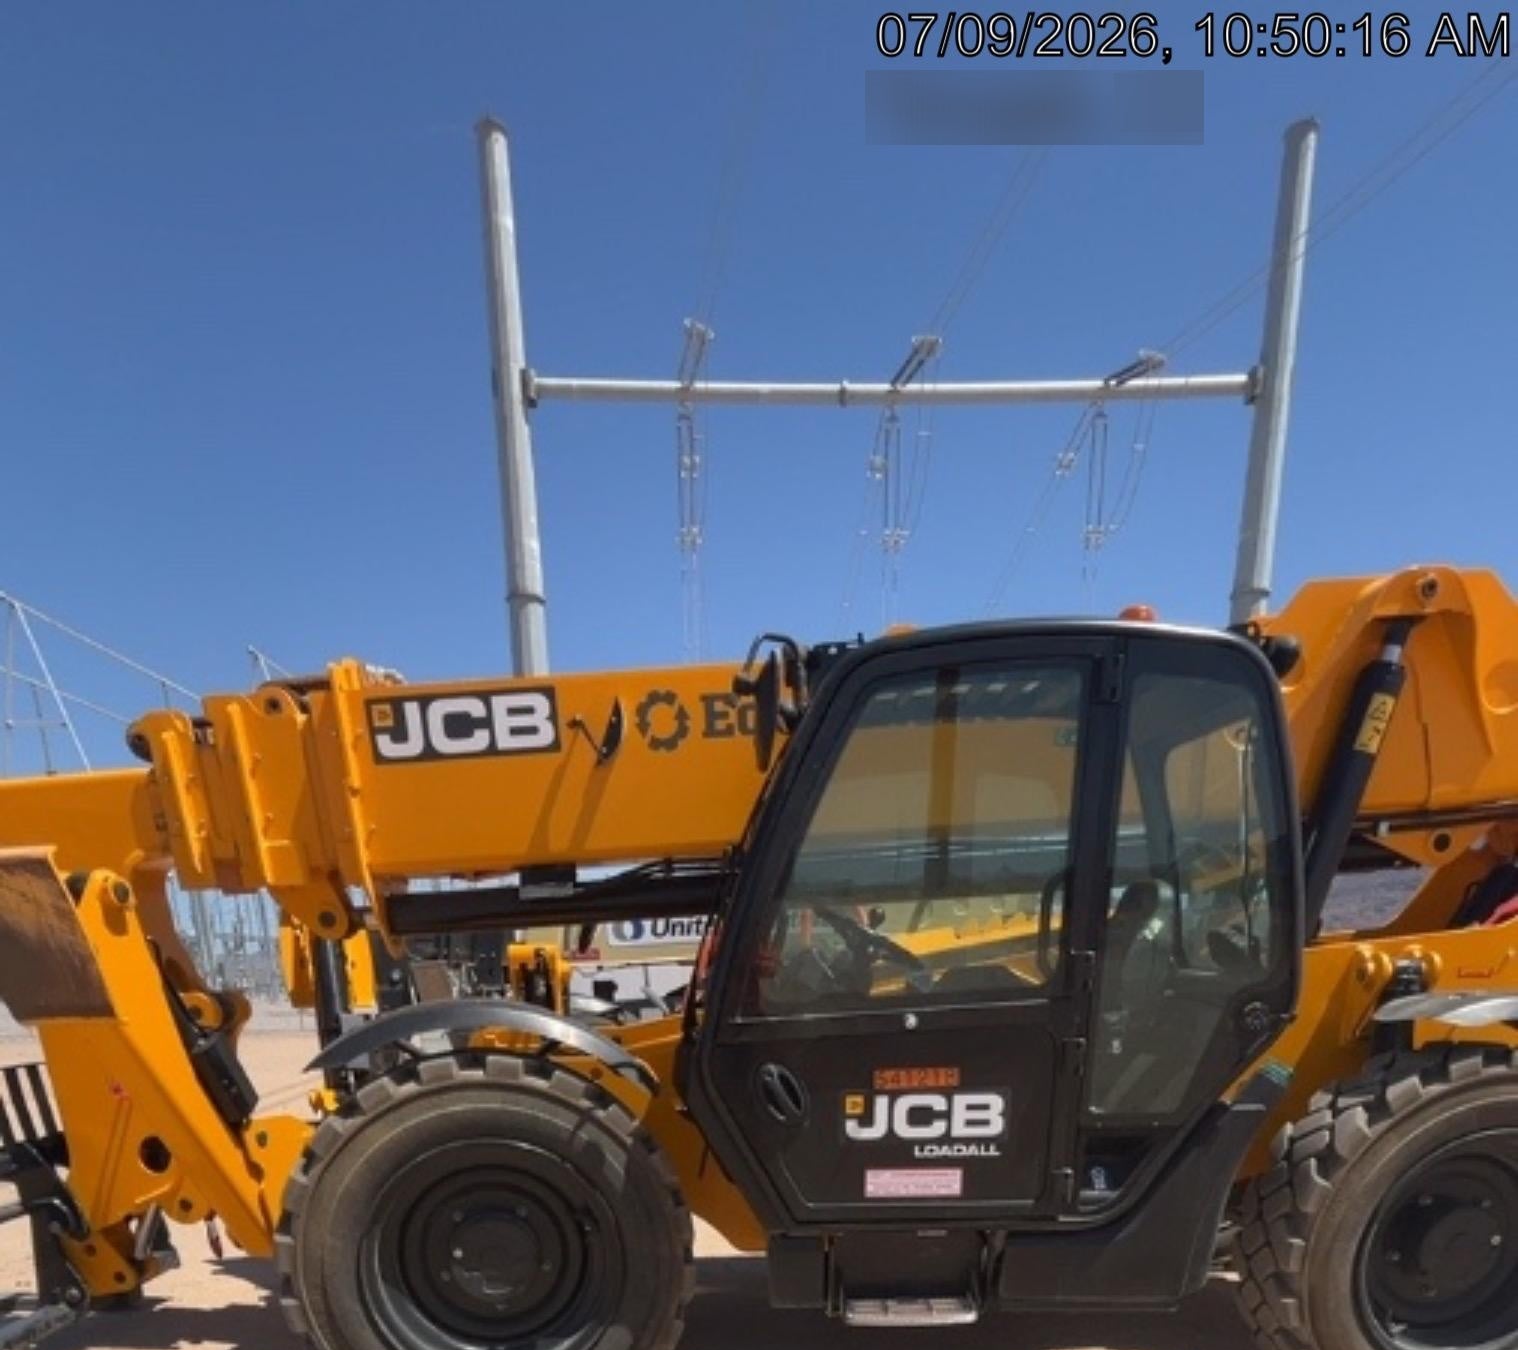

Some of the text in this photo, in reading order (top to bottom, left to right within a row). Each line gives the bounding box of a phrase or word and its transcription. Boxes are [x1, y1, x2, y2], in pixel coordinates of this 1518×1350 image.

[375, 692, 556, 759] JCB
[845, 1093, 1005, 1140] JCB
[914, 1144, 1001, 1158] LOADALL
